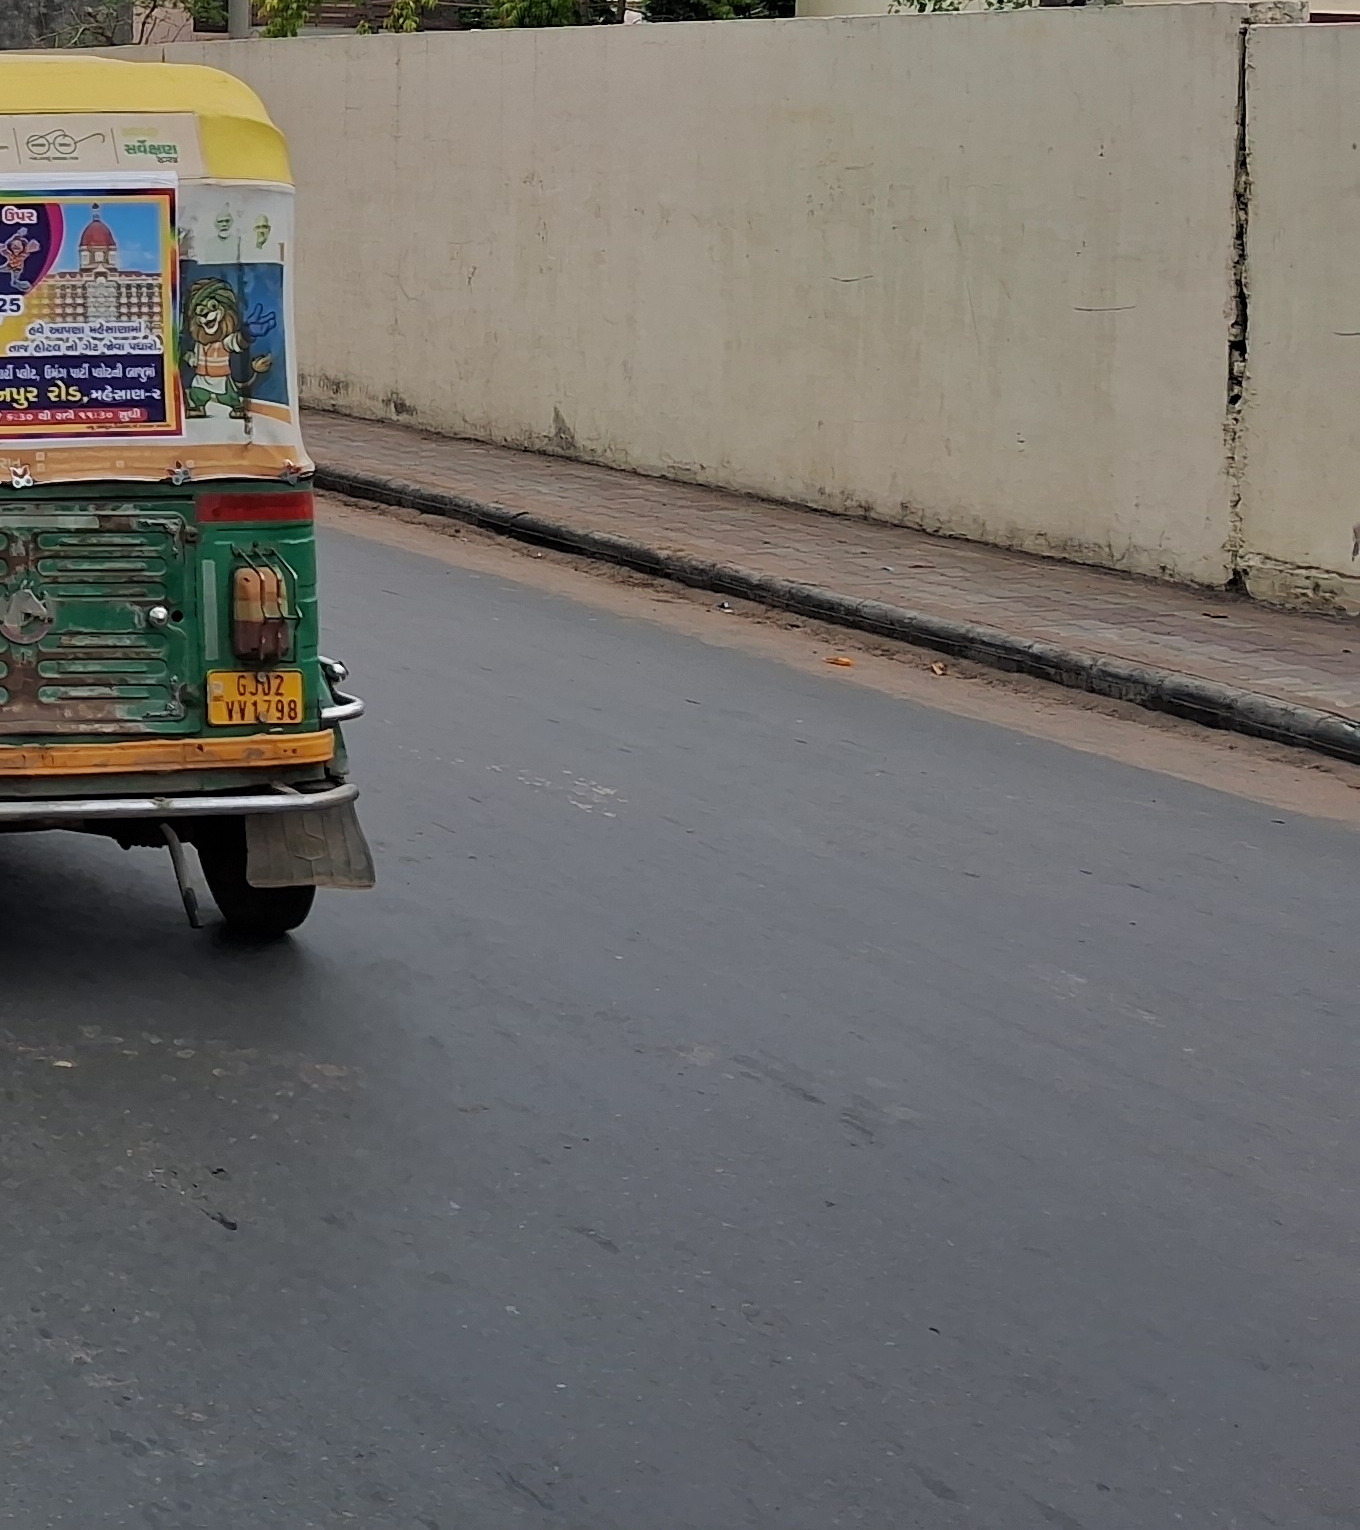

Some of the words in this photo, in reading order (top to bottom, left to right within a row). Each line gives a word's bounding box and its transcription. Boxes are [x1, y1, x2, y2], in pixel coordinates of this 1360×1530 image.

[124, 139, 179, 156] સર્વેક્ષણ
[3, 207, 36, 223] ઉપર
[28, 322, 44, 335] હવે
[8, 342, 29, 353] તાજ
[33, 339, 62, 353] હોટલ
[65, 339, 78, 352] નો
[81, 339, 99, 352] ગેટ
[102, 339, 125, 351] જોવા
[47, 379, 89, 404] રોડ,
[38, 410, 51, 421] થી
[118, 408, 141, 422] સુધી
[236, 674, 285, 697] GJ02
[225, 698, 299, 722] VV1798
